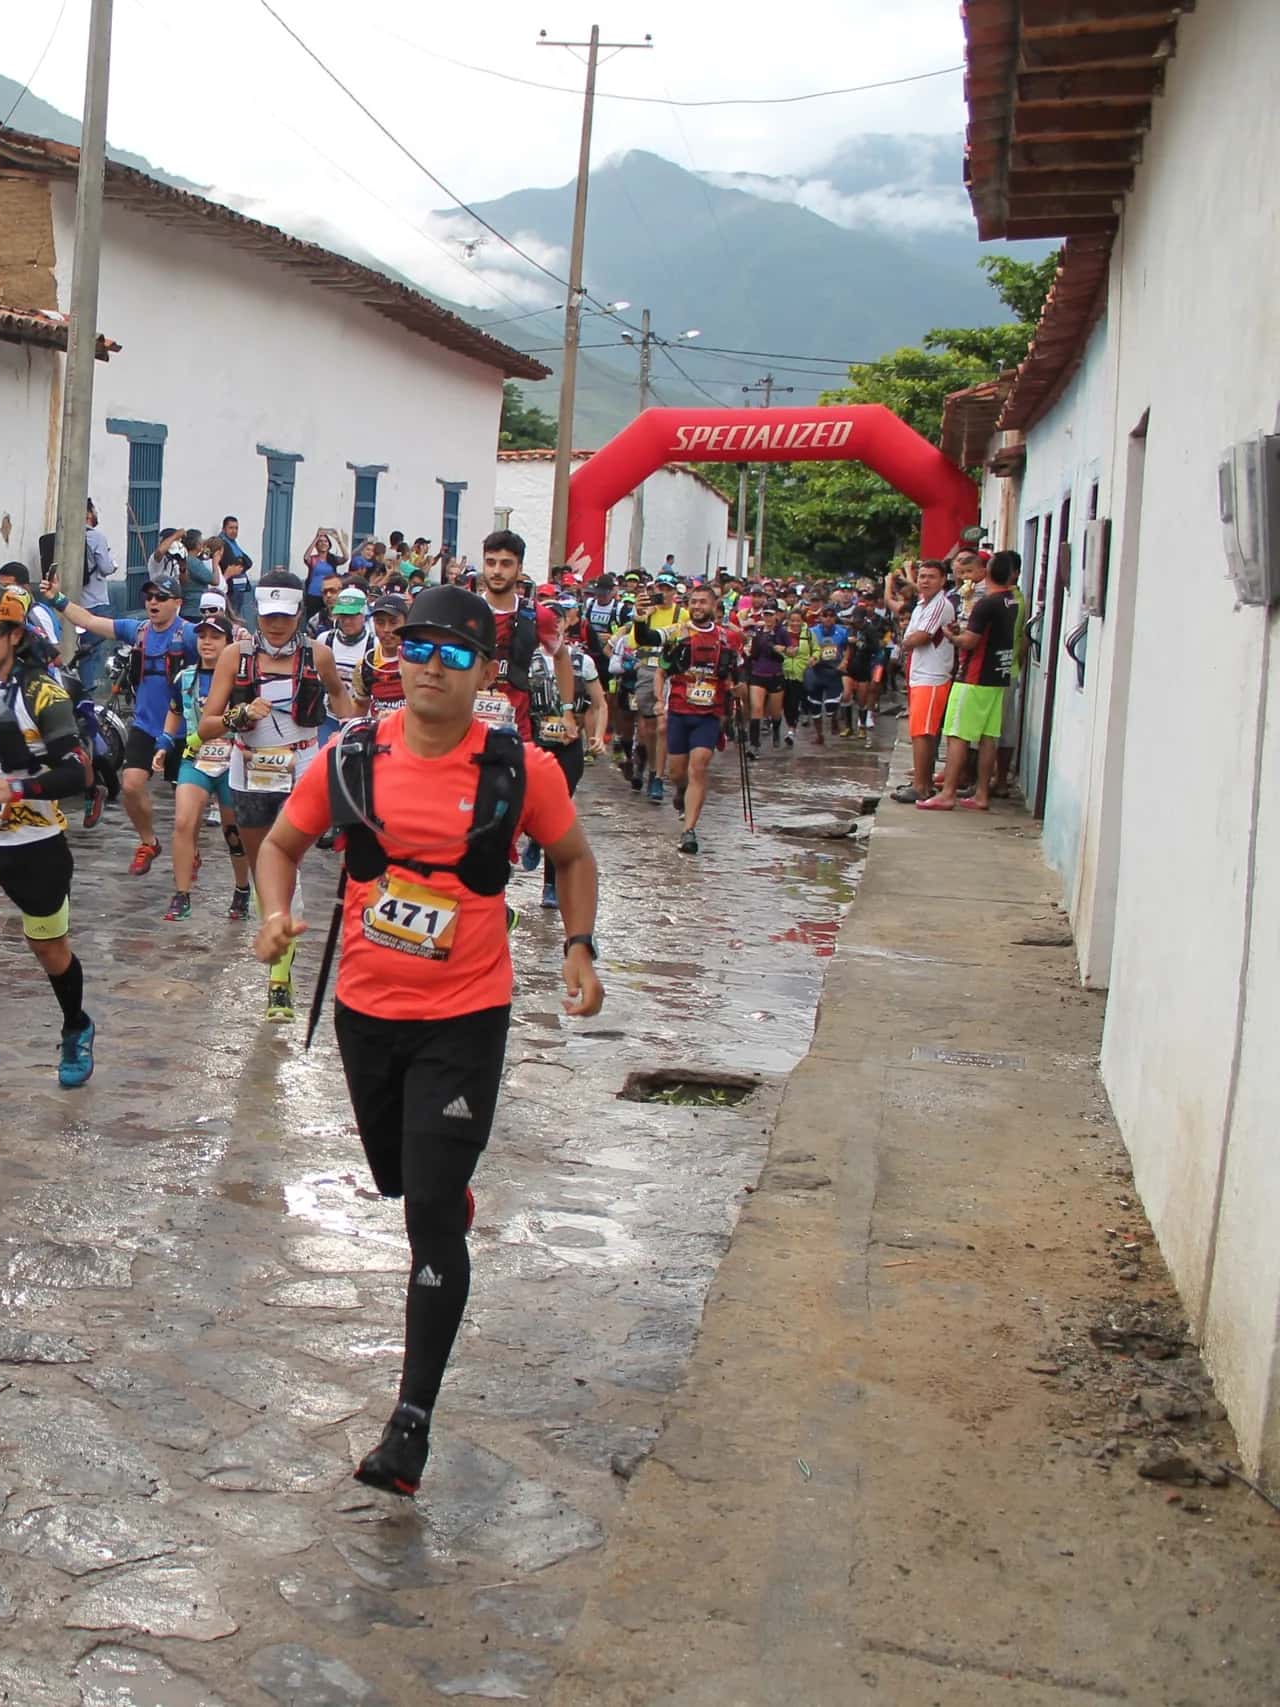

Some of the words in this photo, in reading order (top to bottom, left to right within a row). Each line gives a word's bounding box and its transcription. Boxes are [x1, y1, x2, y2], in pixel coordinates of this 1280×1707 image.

[669, 421, 853, 450] SPECIALIZED
[694, 689, 713, 698] 479
[477, 701, 501, 712] 564
[203, 746, 225, 756] 526
[379, 899, 439, 935] 471
